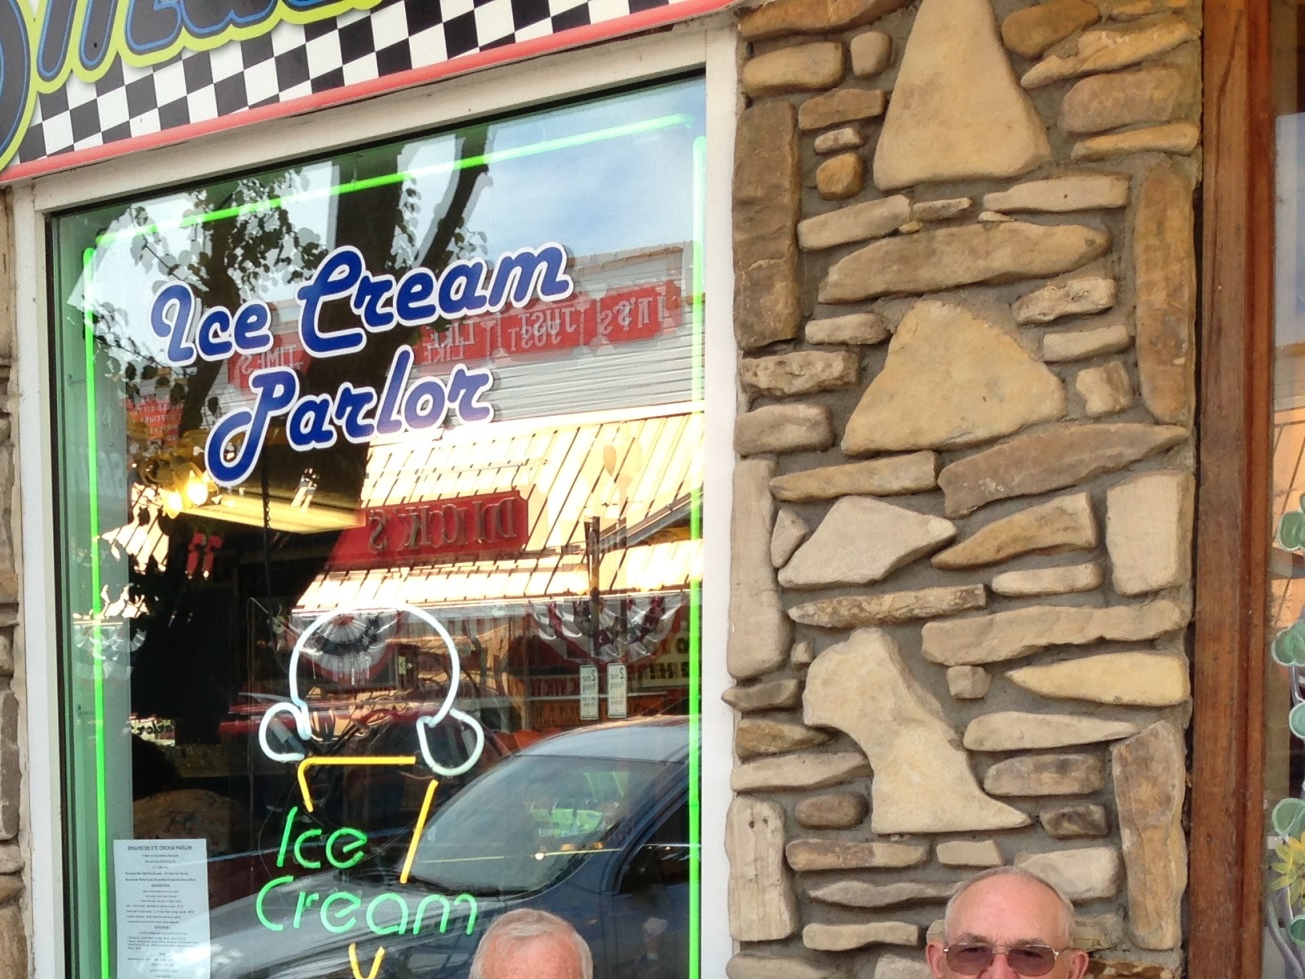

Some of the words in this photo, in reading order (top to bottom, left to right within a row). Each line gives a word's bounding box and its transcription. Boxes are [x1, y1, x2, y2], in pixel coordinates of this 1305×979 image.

[151, 281, 272, 366] Ice
[297, 245, 574, 358] Cream
[206, 345, 494, 487] Parlor
[276, 806, 367, 869] Ice
[256, 876, 478, 935] Cream
